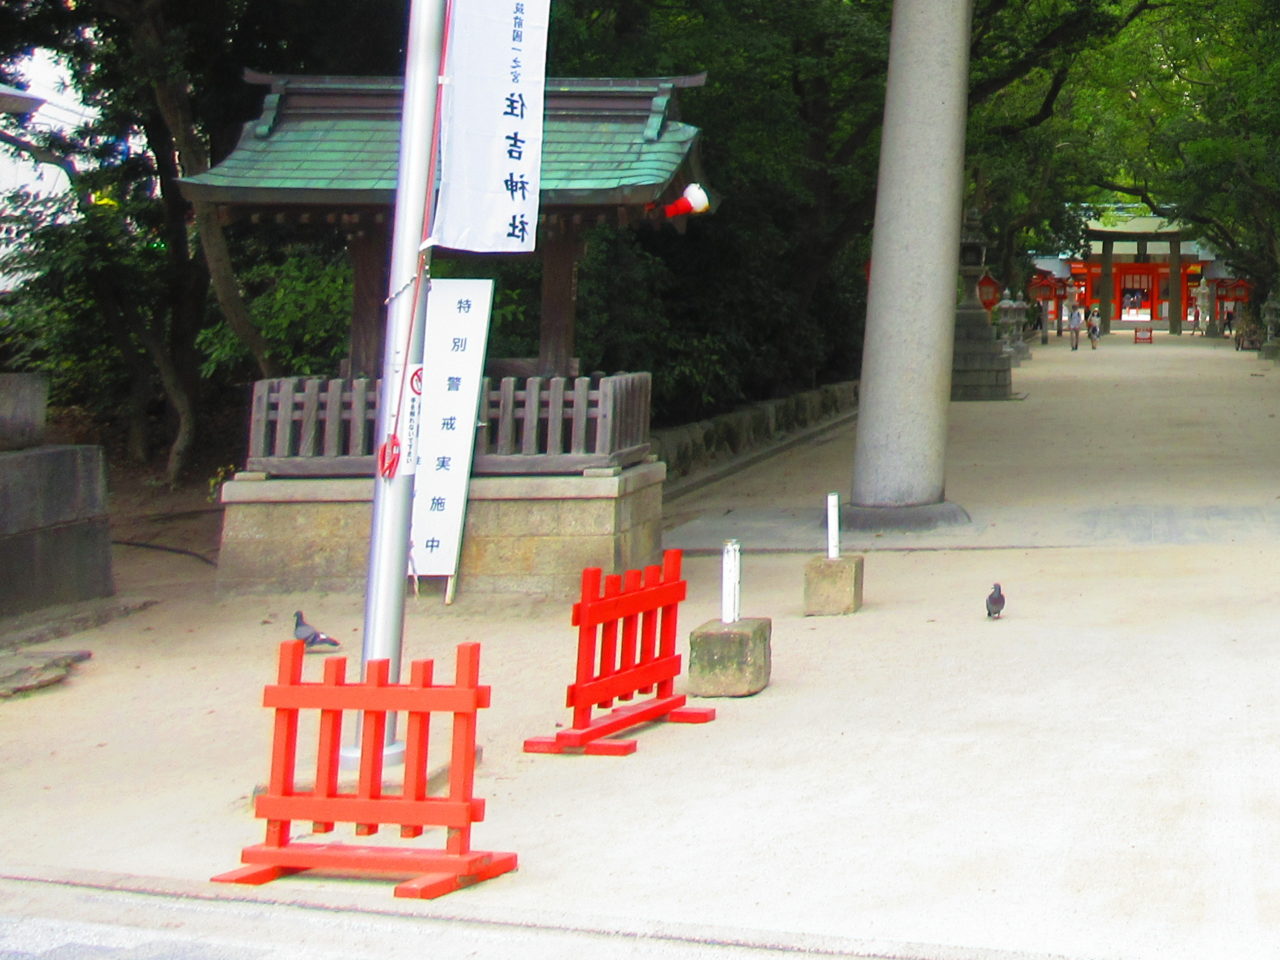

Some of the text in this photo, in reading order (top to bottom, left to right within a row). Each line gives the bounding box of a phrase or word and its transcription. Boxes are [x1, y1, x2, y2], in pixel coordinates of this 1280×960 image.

[425, 298, 472, 554] 特別警戒実施中
